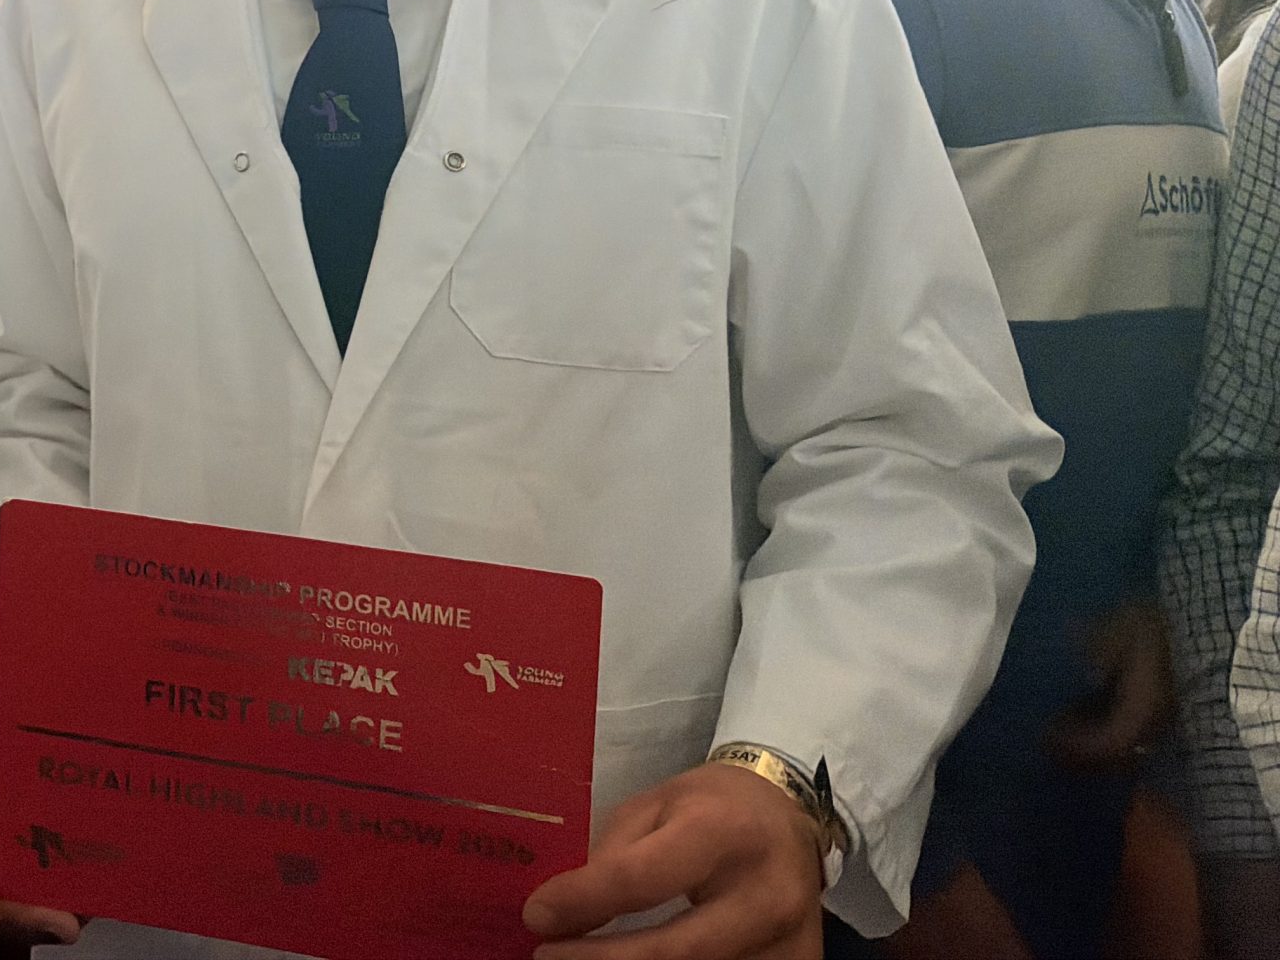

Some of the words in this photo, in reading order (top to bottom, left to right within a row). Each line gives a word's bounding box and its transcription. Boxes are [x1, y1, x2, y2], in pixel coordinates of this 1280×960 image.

[299, 585, 471, 629] PROGRAMME
[325, 615, 393, 637] SECTION
[287, 656, 399, 696] KEPAK
[145, 679, 254, 725] FIRST
[268, 699, 404, 753] PLACE
[729, 750, 761, 763] SAT
